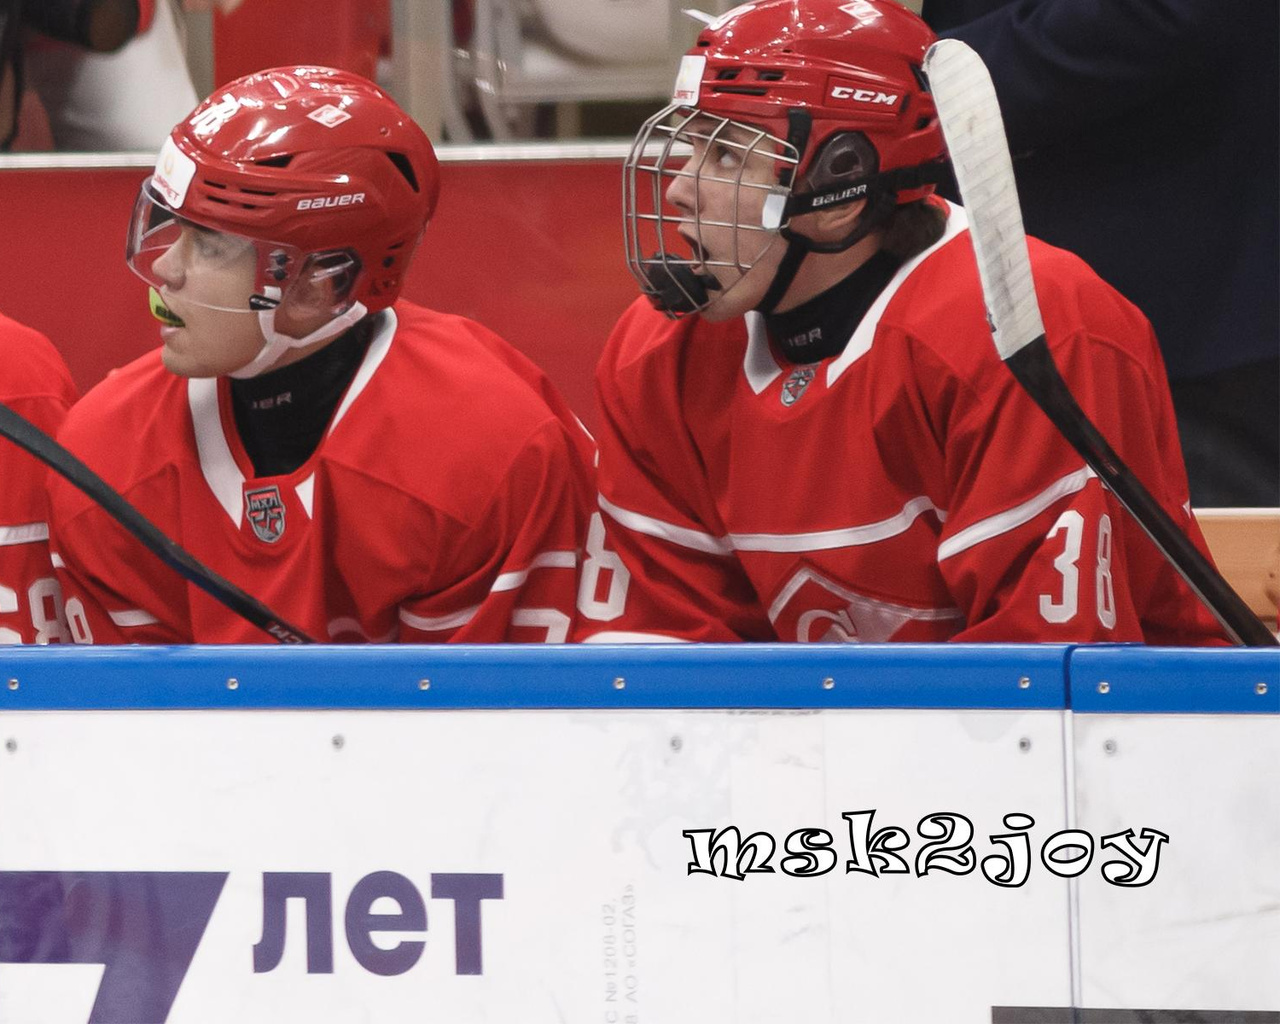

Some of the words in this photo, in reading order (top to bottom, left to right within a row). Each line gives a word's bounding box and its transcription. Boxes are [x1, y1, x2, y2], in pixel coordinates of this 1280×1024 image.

[830, 85, 899, 106] CCM
[296, 192, 366, 211] BAUER
[811, 183, 868, 208] BAUER
[1039, 509, 1117, 630] 38
[252, 869, 505, 976] лет
